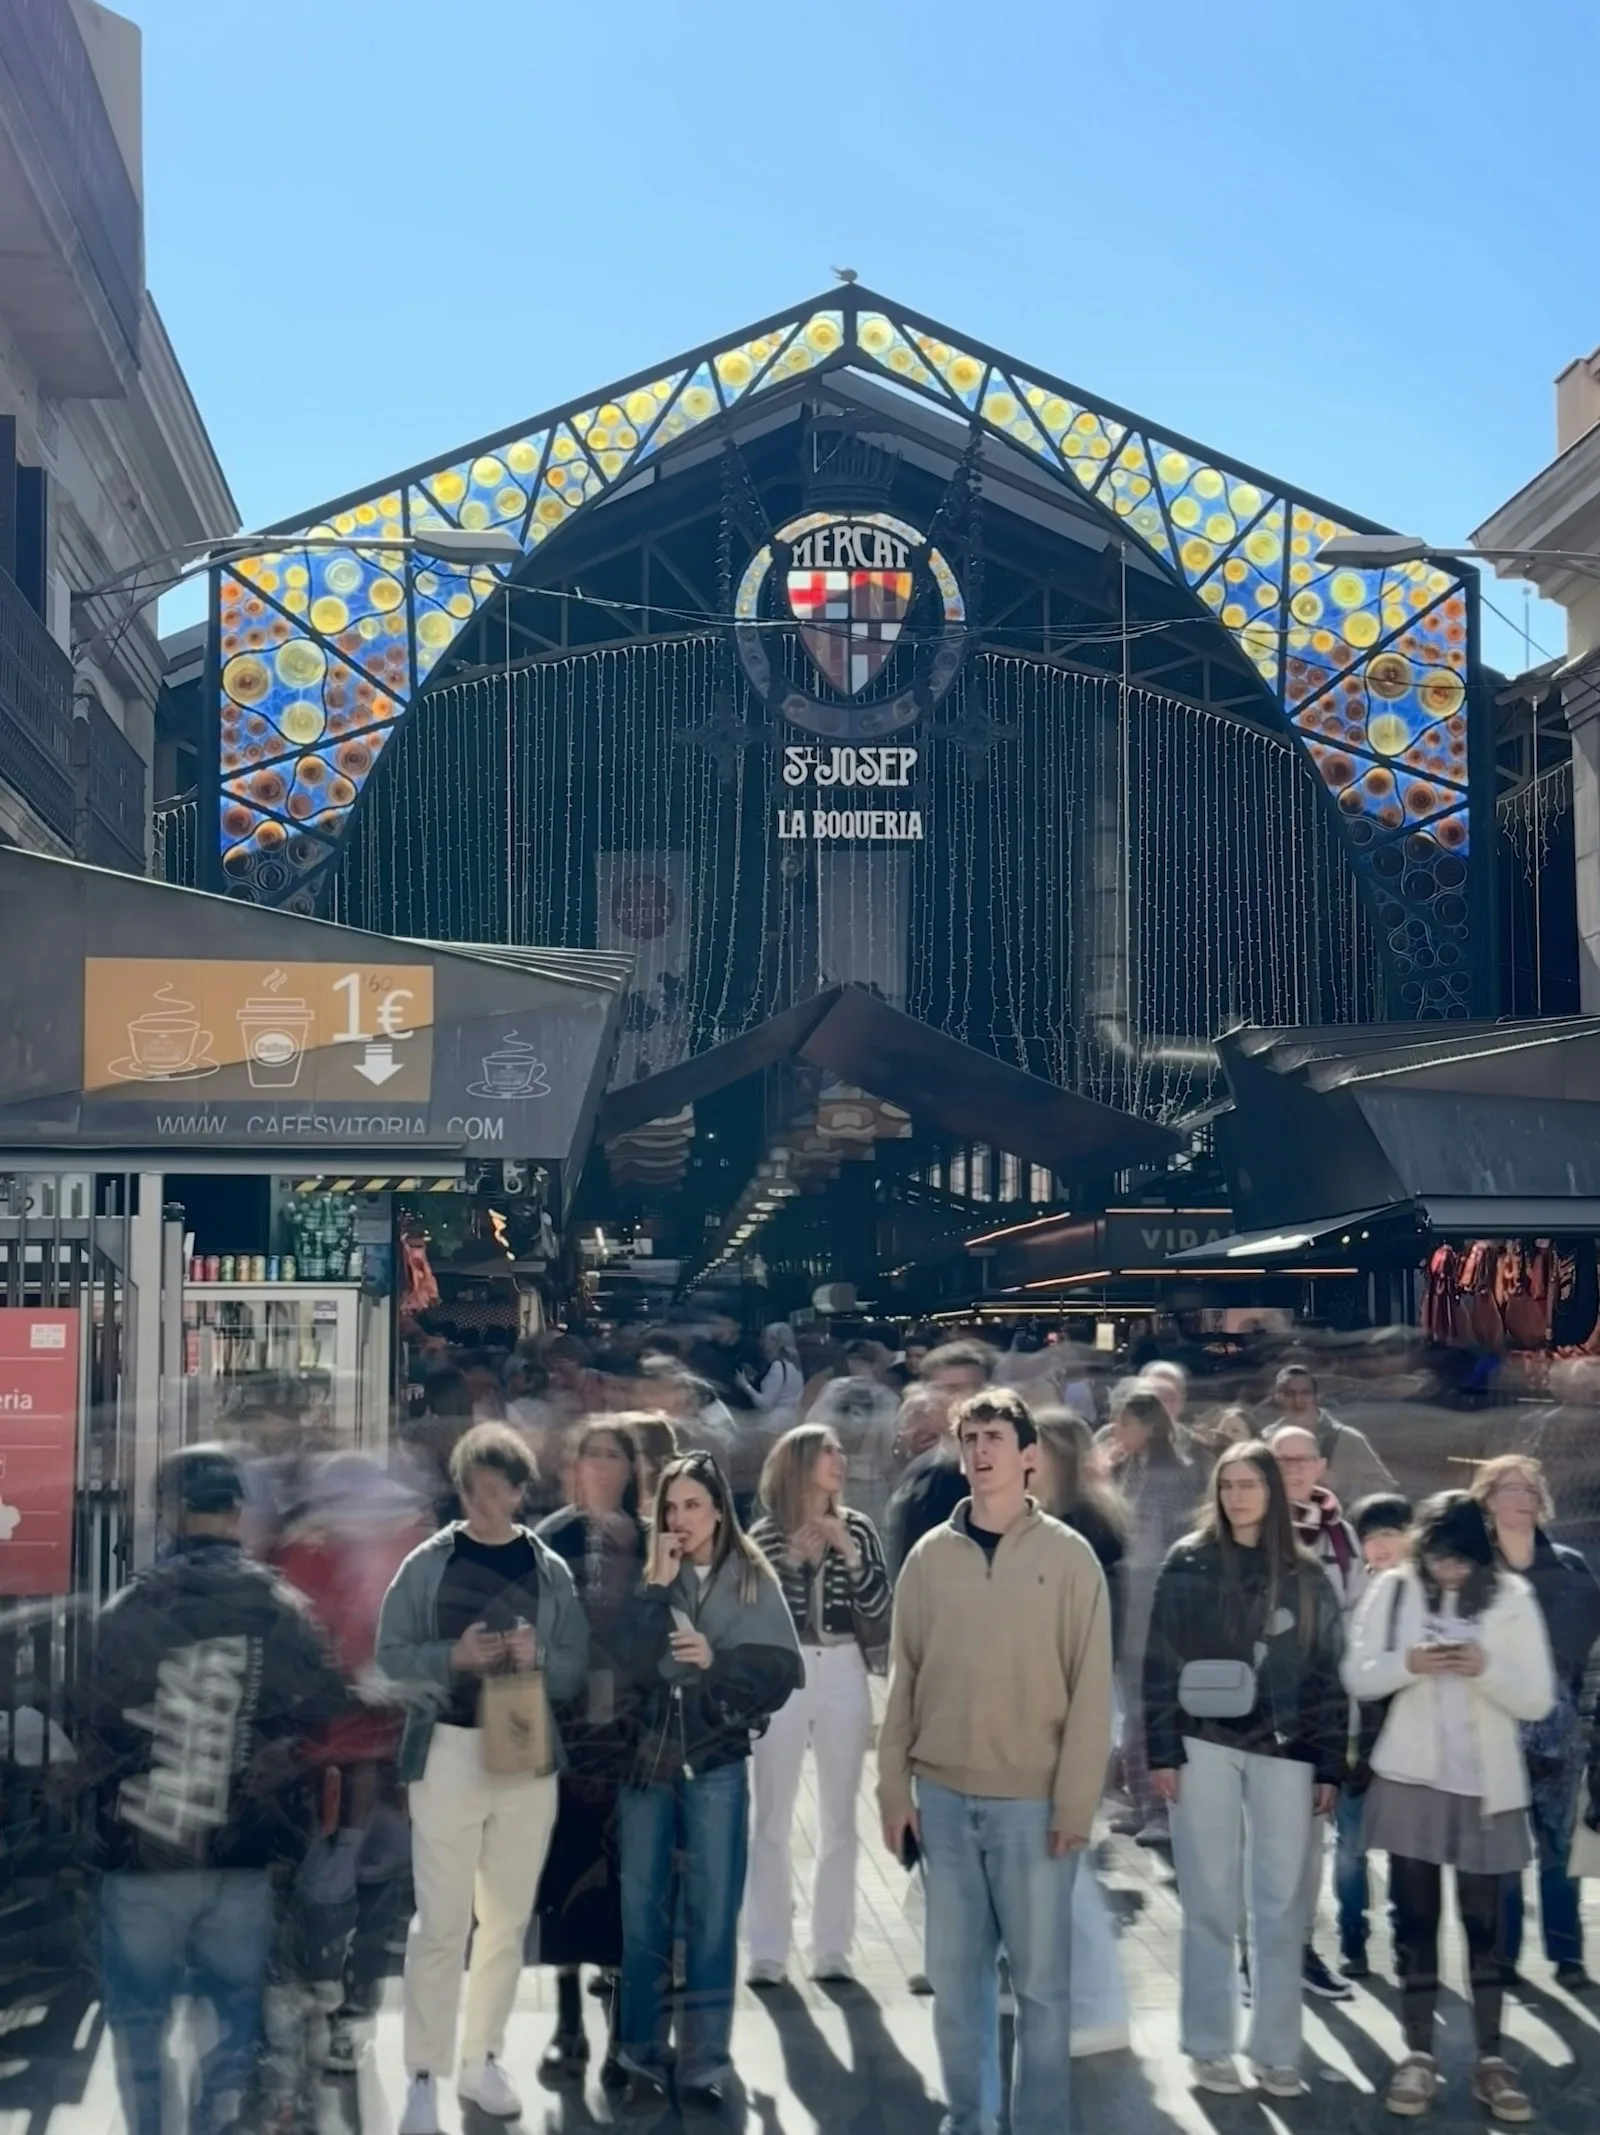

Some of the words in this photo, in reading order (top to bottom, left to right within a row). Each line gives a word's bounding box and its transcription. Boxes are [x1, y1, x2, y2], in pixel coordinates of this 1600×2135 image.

[792, 526, 909, 567] MERCAT
[814, 747, 918, 786] JOSEP
[778, 810, 806, 838] LA
[812, 810, 923, 839] BOQUERIA
[1141, 1228, 1236, 1250] VIDA
